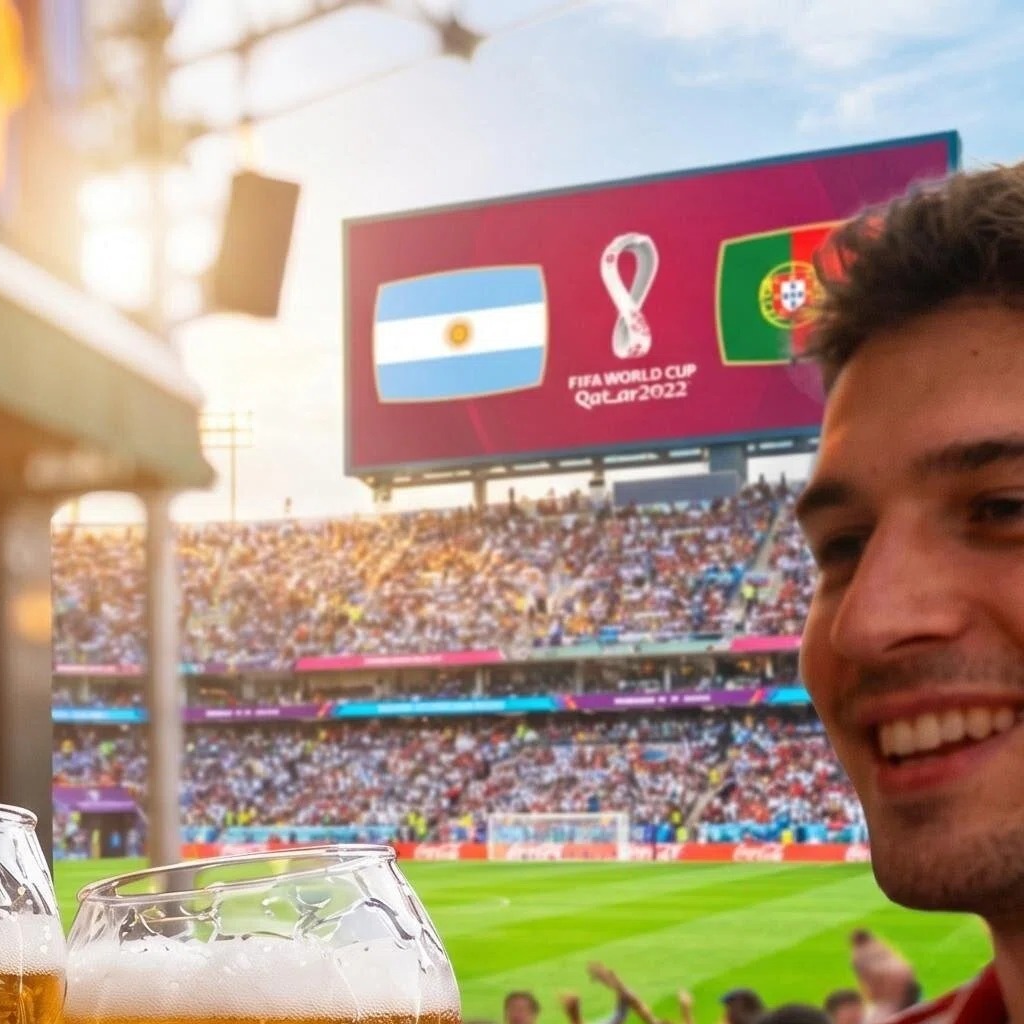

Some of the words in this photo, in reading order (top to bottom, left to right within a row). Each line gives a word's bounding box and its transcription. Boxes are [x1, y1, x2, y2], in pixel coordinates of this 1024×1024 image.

[568, 374, 603, 390] FIFA
[604, 367, 663, 385] WORLD
[665, 364, 697, 379] CUP
